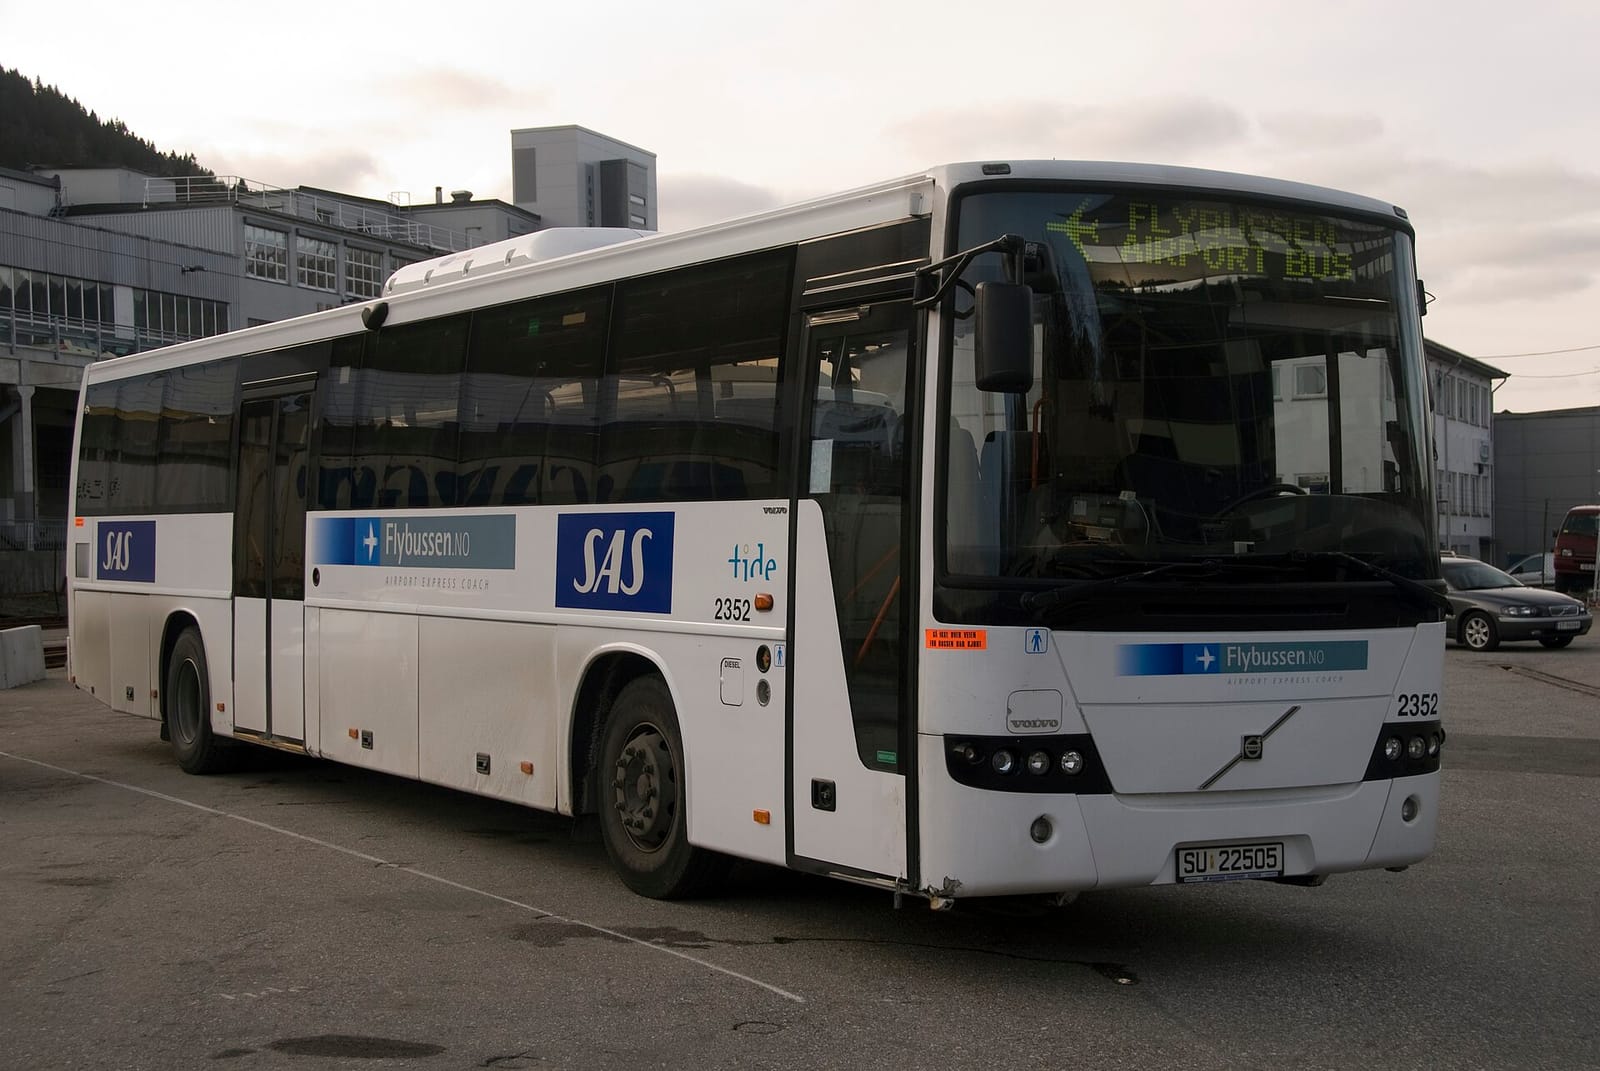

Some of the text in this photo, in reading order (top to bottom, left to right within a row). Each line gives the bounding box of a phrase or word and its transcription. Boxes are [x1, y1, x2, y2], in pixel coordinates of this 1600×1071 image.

[1128, 203, 1336, 247] FLYBUSSEN
[1121, 234, 1353, 281] AIRPORT BUS
[102, 531, 133, 571] SAS
[573, 528, 653, 596] SAS
[728, 543, 777, 582] tide
[385, 576, 490, 591] AIRPORT EXPRESS COACH
[714, 598, 751, 621] 2352
[724, 659, 741, 669] DIESEL
[1227, 677, 1268, 685] AIRPORT
[1397, 693, 1438, 717] 2352
[1010, 719, 1059, 728] VOLVO
[1184, 847, 1277, 874] SU 22505
